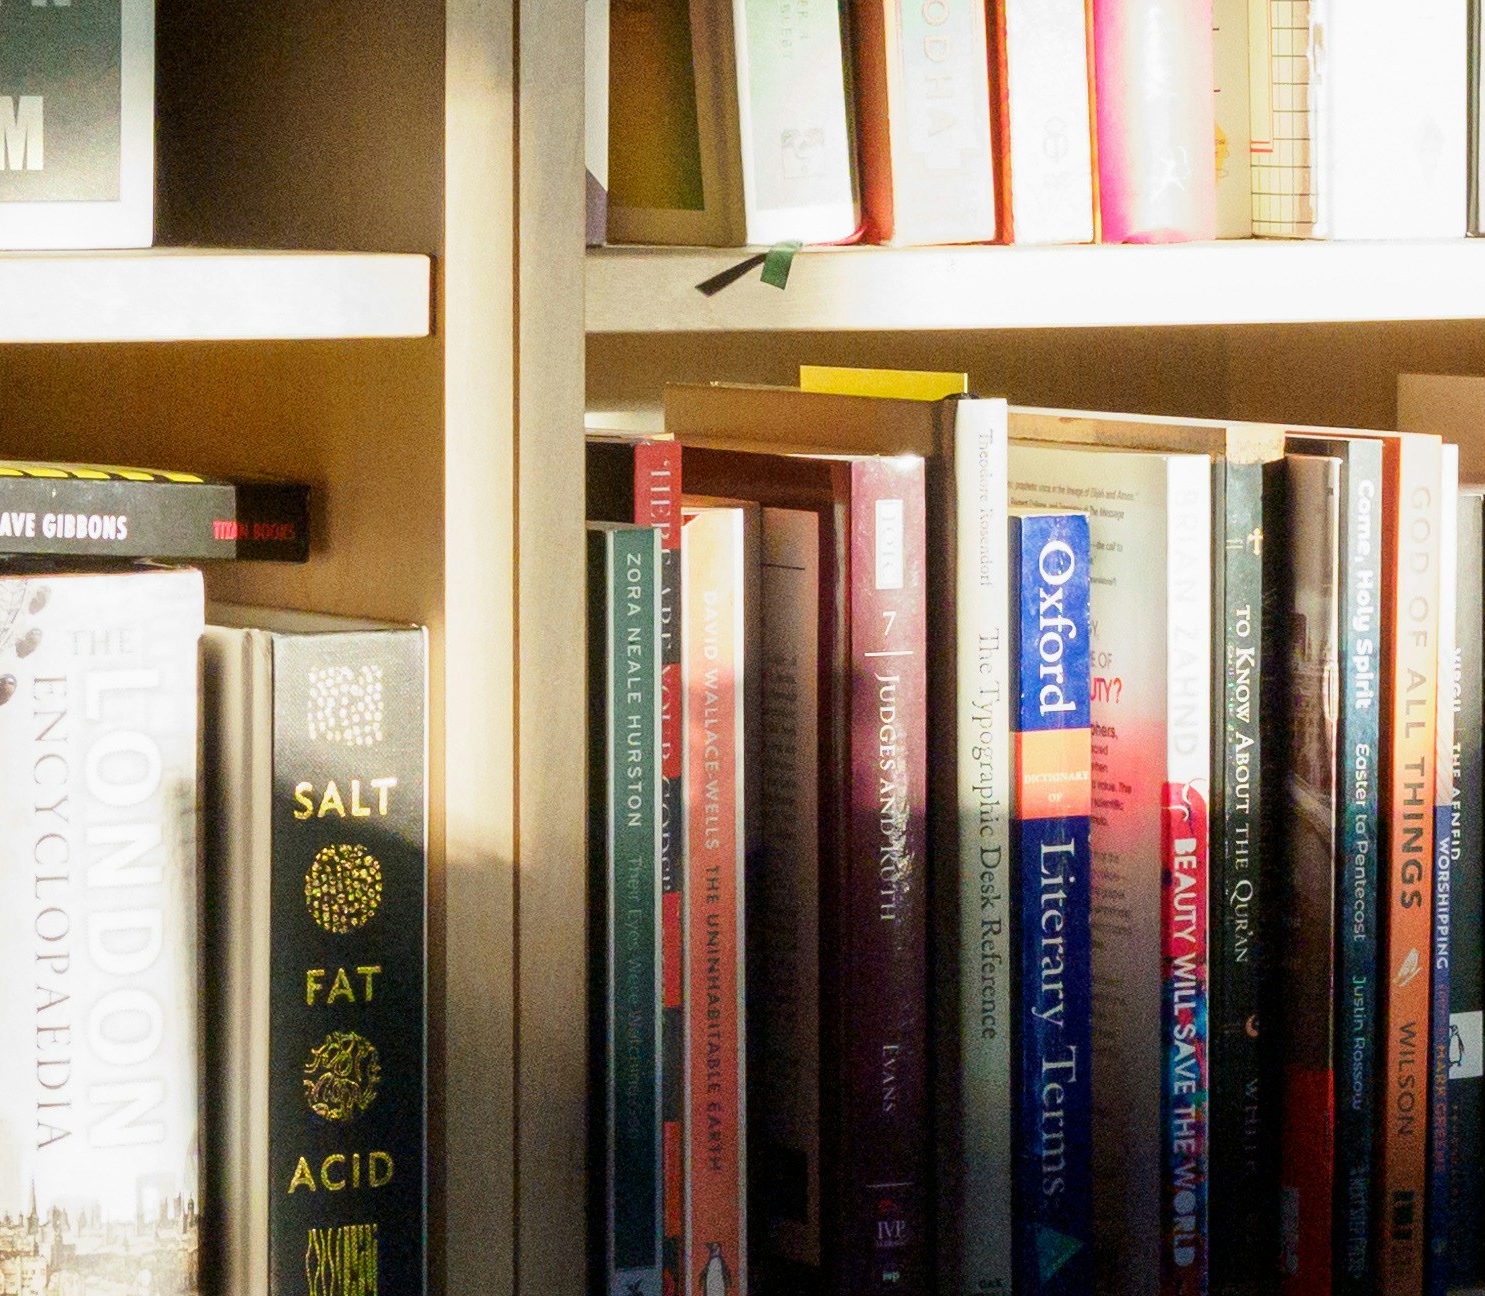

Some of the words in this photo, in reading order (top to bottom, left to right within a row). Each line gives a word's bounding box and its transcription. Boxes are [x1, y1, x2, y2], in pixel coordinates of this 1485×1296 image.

[38, 514, 129, 543] GIBBONS
[1351, 479, 1377, 563] Come,
[1036, 539, 1079, 717] Oxford
[1349, 568, 1377, 632] Holy
[1404, 600, 1431, 655] OF
[977, 628, 1003, 675] The
[1352, 638, 1377, 710] Spirit
[1402, 667, 1431, 746] ALL
[969, 682, 1004, 839] Typographic
[1352, 742, 1372, 806] Easter
[291, 777, 398, 823] SALT
[1352, 812, 1371, 837] to
[1398, 757, 1426, 911] THINGS
[80, 671, 170, 1153] LONDON
[977, 848, 1003, 912] Desk
[1352, 840, 1371, 943] Pentecost
[1029, 840, 1079, 1027] Literary
[303, 966, 382, 1007] FAT
[977, 916, 1006, 1041] Reference
[1351, 975, 1369, 1030] Justin
[1352, 1036, 1369, 1111] Rossow
[1396, 1020, 1420, 1137] WILSON
[1036, 1045, 1077, 1197] Terms
[287, 1152, 398, 1194] ACID
